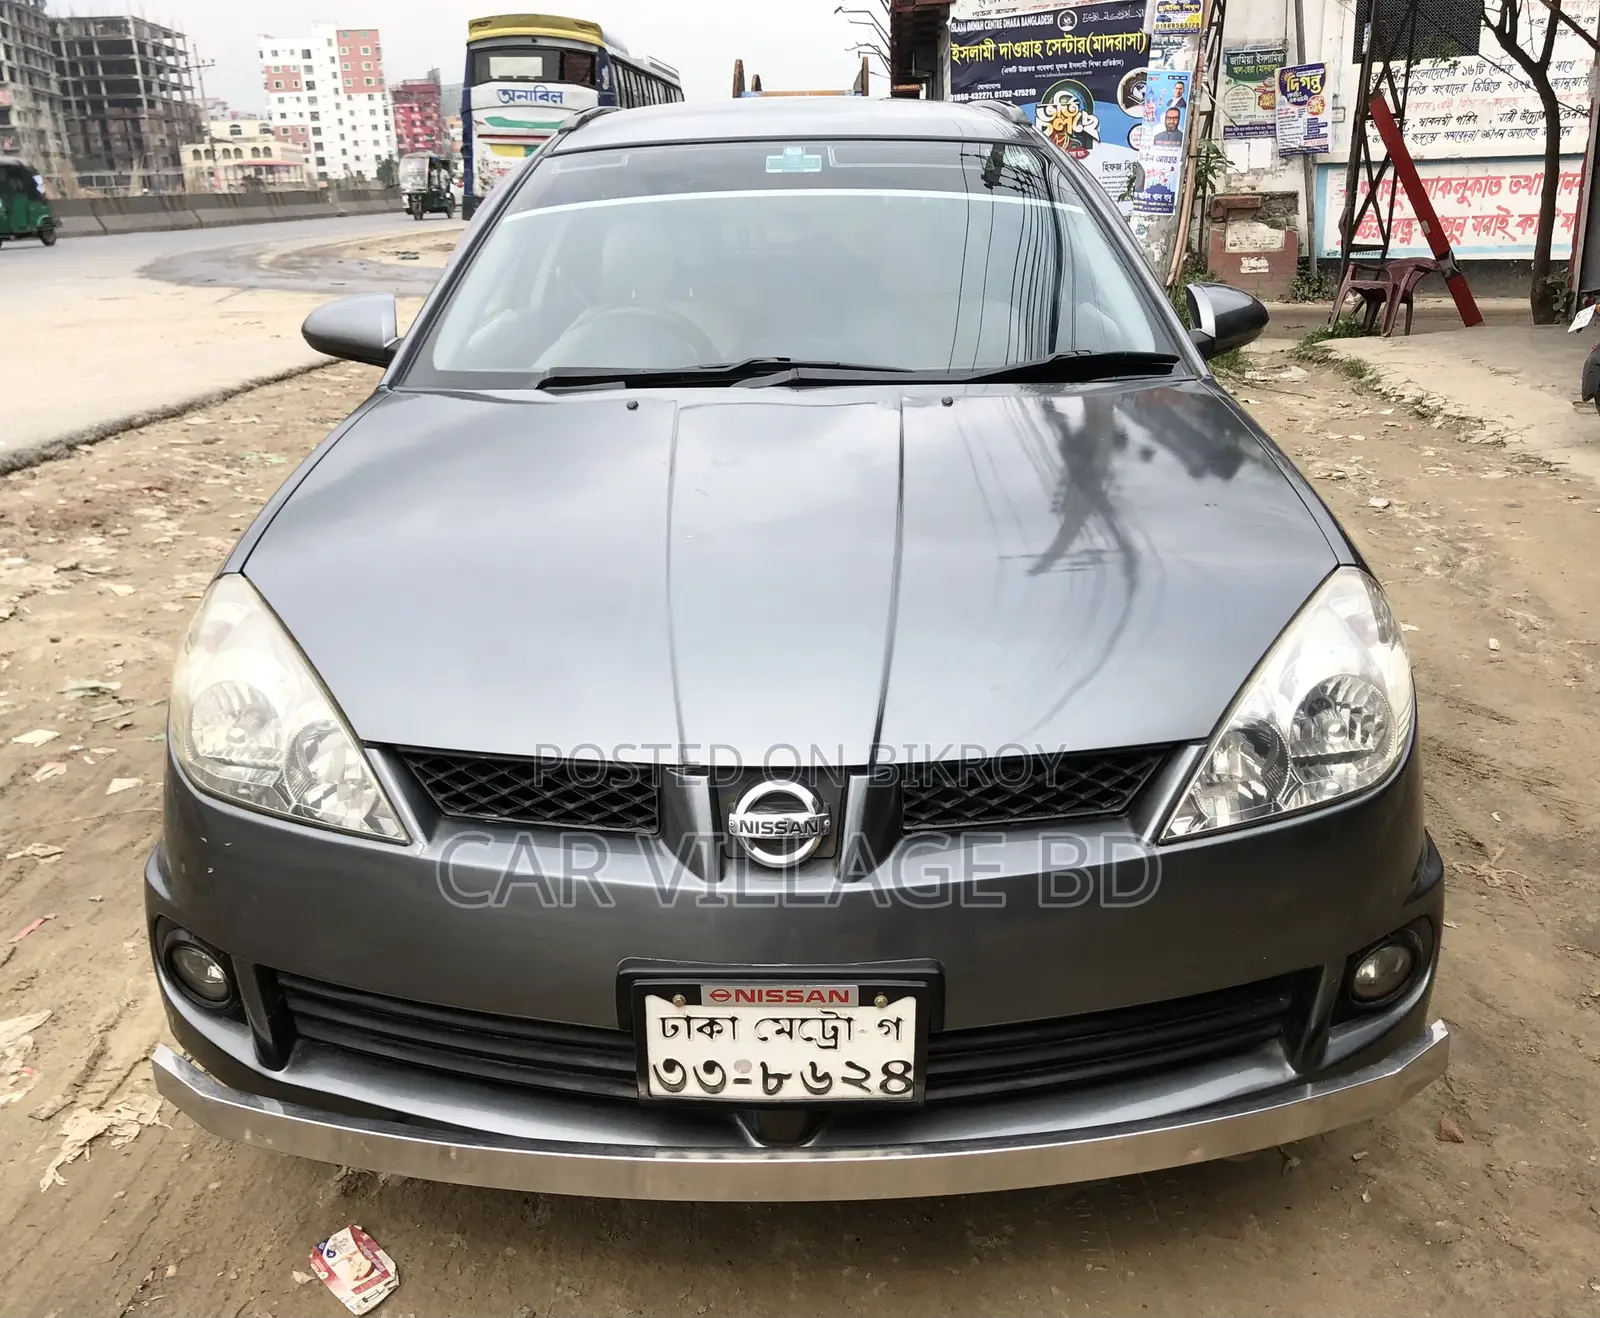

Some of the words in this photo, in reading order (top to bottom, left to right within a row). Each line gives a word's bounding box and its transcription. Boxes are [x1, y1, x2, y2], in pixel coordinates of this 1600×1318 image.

[950, 37, 996, 65] ইসলামী
[998, 39, 1044, 60] দাওয়াহ
[497, 85, 564, 105] অনাবিল
[1286, 72, 1322, 94] দিগন্ত
[1508, 172, 1545, 196] তথা
[1471, 205, 1518, 243] সবাই
[739, 819, 819, 836] NISSAN
[734, 989, 849, 1004] NISSAN
[659, 1014, 739, 1042] ঢাকা
[652, 1057, 915, 1095] ৩৩-৮৬২৪
